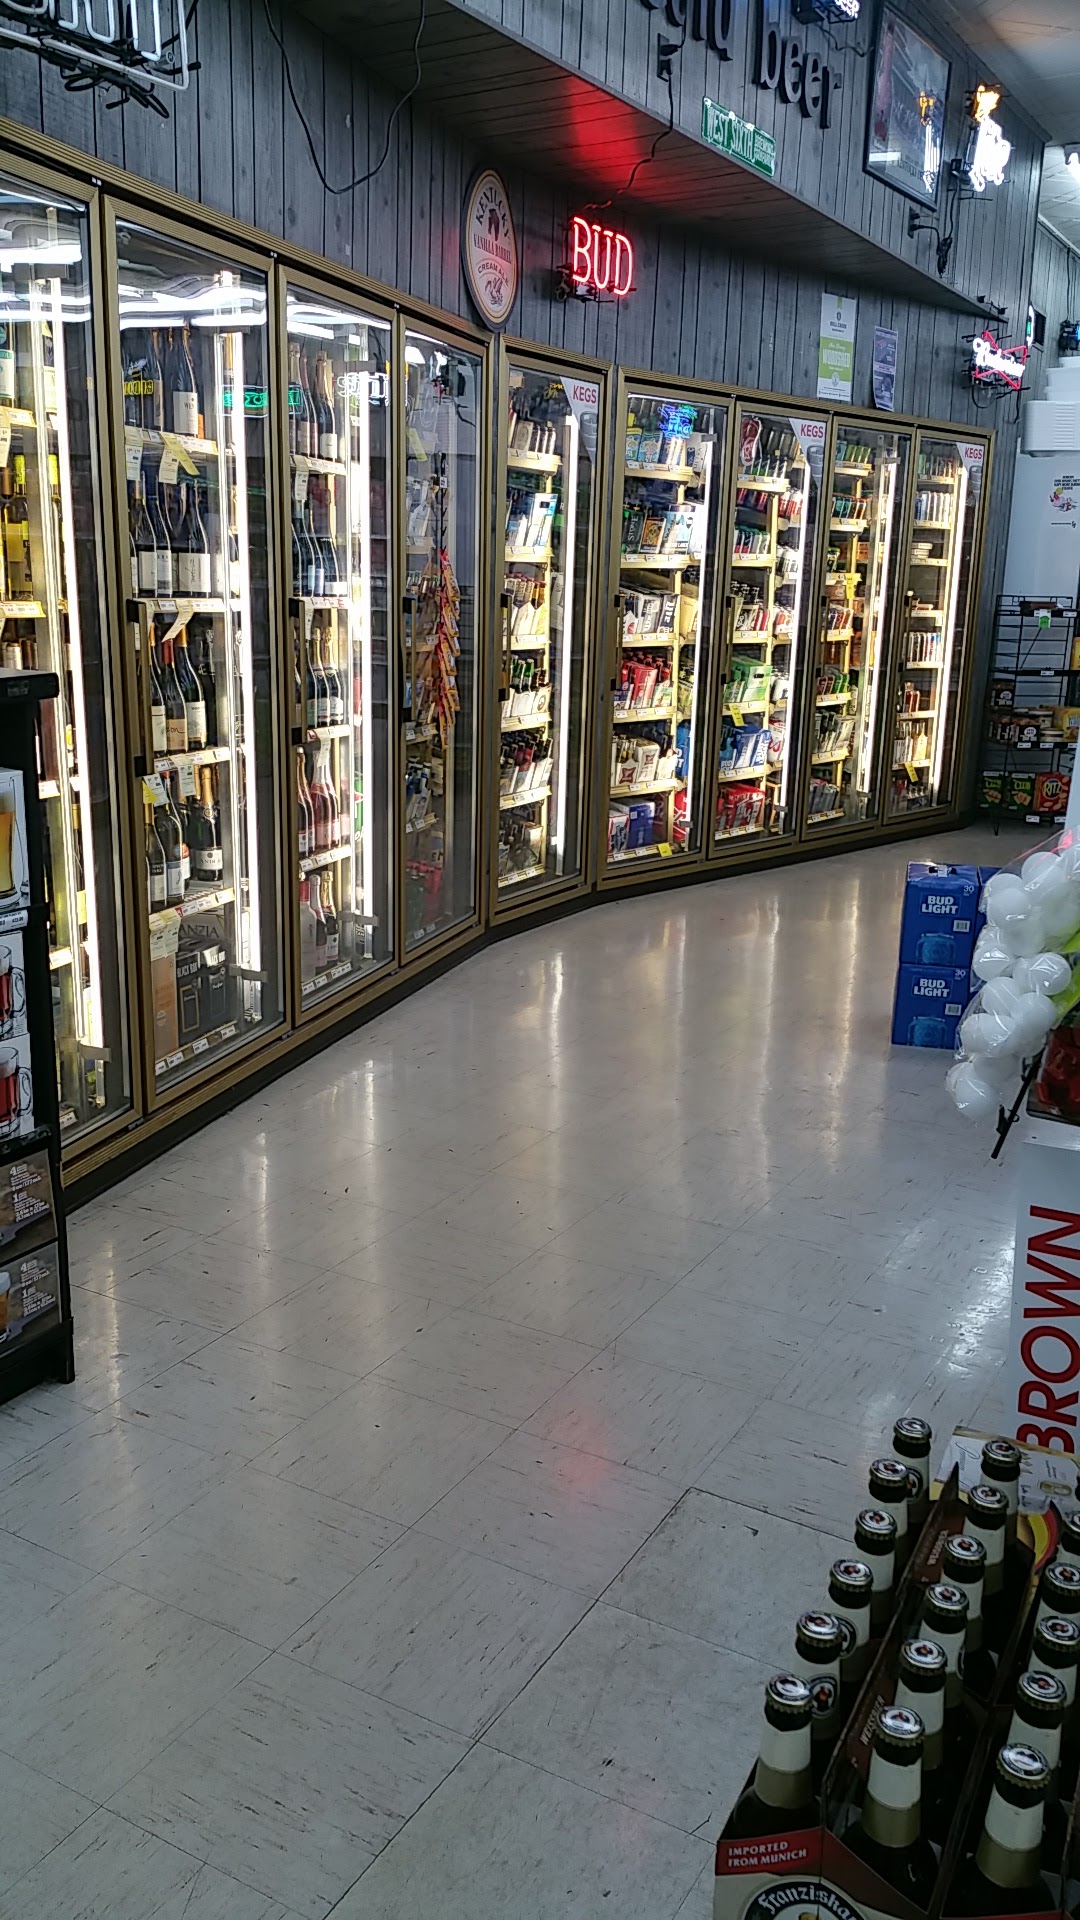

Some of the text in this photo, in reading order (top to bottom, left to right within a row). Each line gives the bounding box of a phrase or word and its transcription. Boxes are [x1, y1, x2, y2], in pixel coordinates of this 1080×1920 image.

[750, 0, 842, 129] beer
[706, 106, 754, 161] WEST SIXTH
[475, 186, 511, 240] KENTUCKY
[473, 233, 495, 256] VANILLA
[572, 216, 633, 295] BUD
[478, 262, 510, 287] CREAM ALE
[573, 384, 597, 404] KEGS
[800, 423, 824, 439] KEGS
[965, 446, 983, 460] KEGS
[1043, 780, 1062, 796] RITZ
[963, 885, 975, 894] 30
[927, 895, 954, 905] BUD
[921, 903, 959, 915] LIGHT
[177, 964, 190, 978] BLACK
[954, 969, 966, 978] 30
[919, 978, 946, 989] BUD
[913, 986, 950, 998] LIGHT
[1016, 1204, 1080, 1455] BROWN
[728, 1841, 788, 1857] IMPORTED
[728, 1848, 807, 1868] FROM MUNICH
